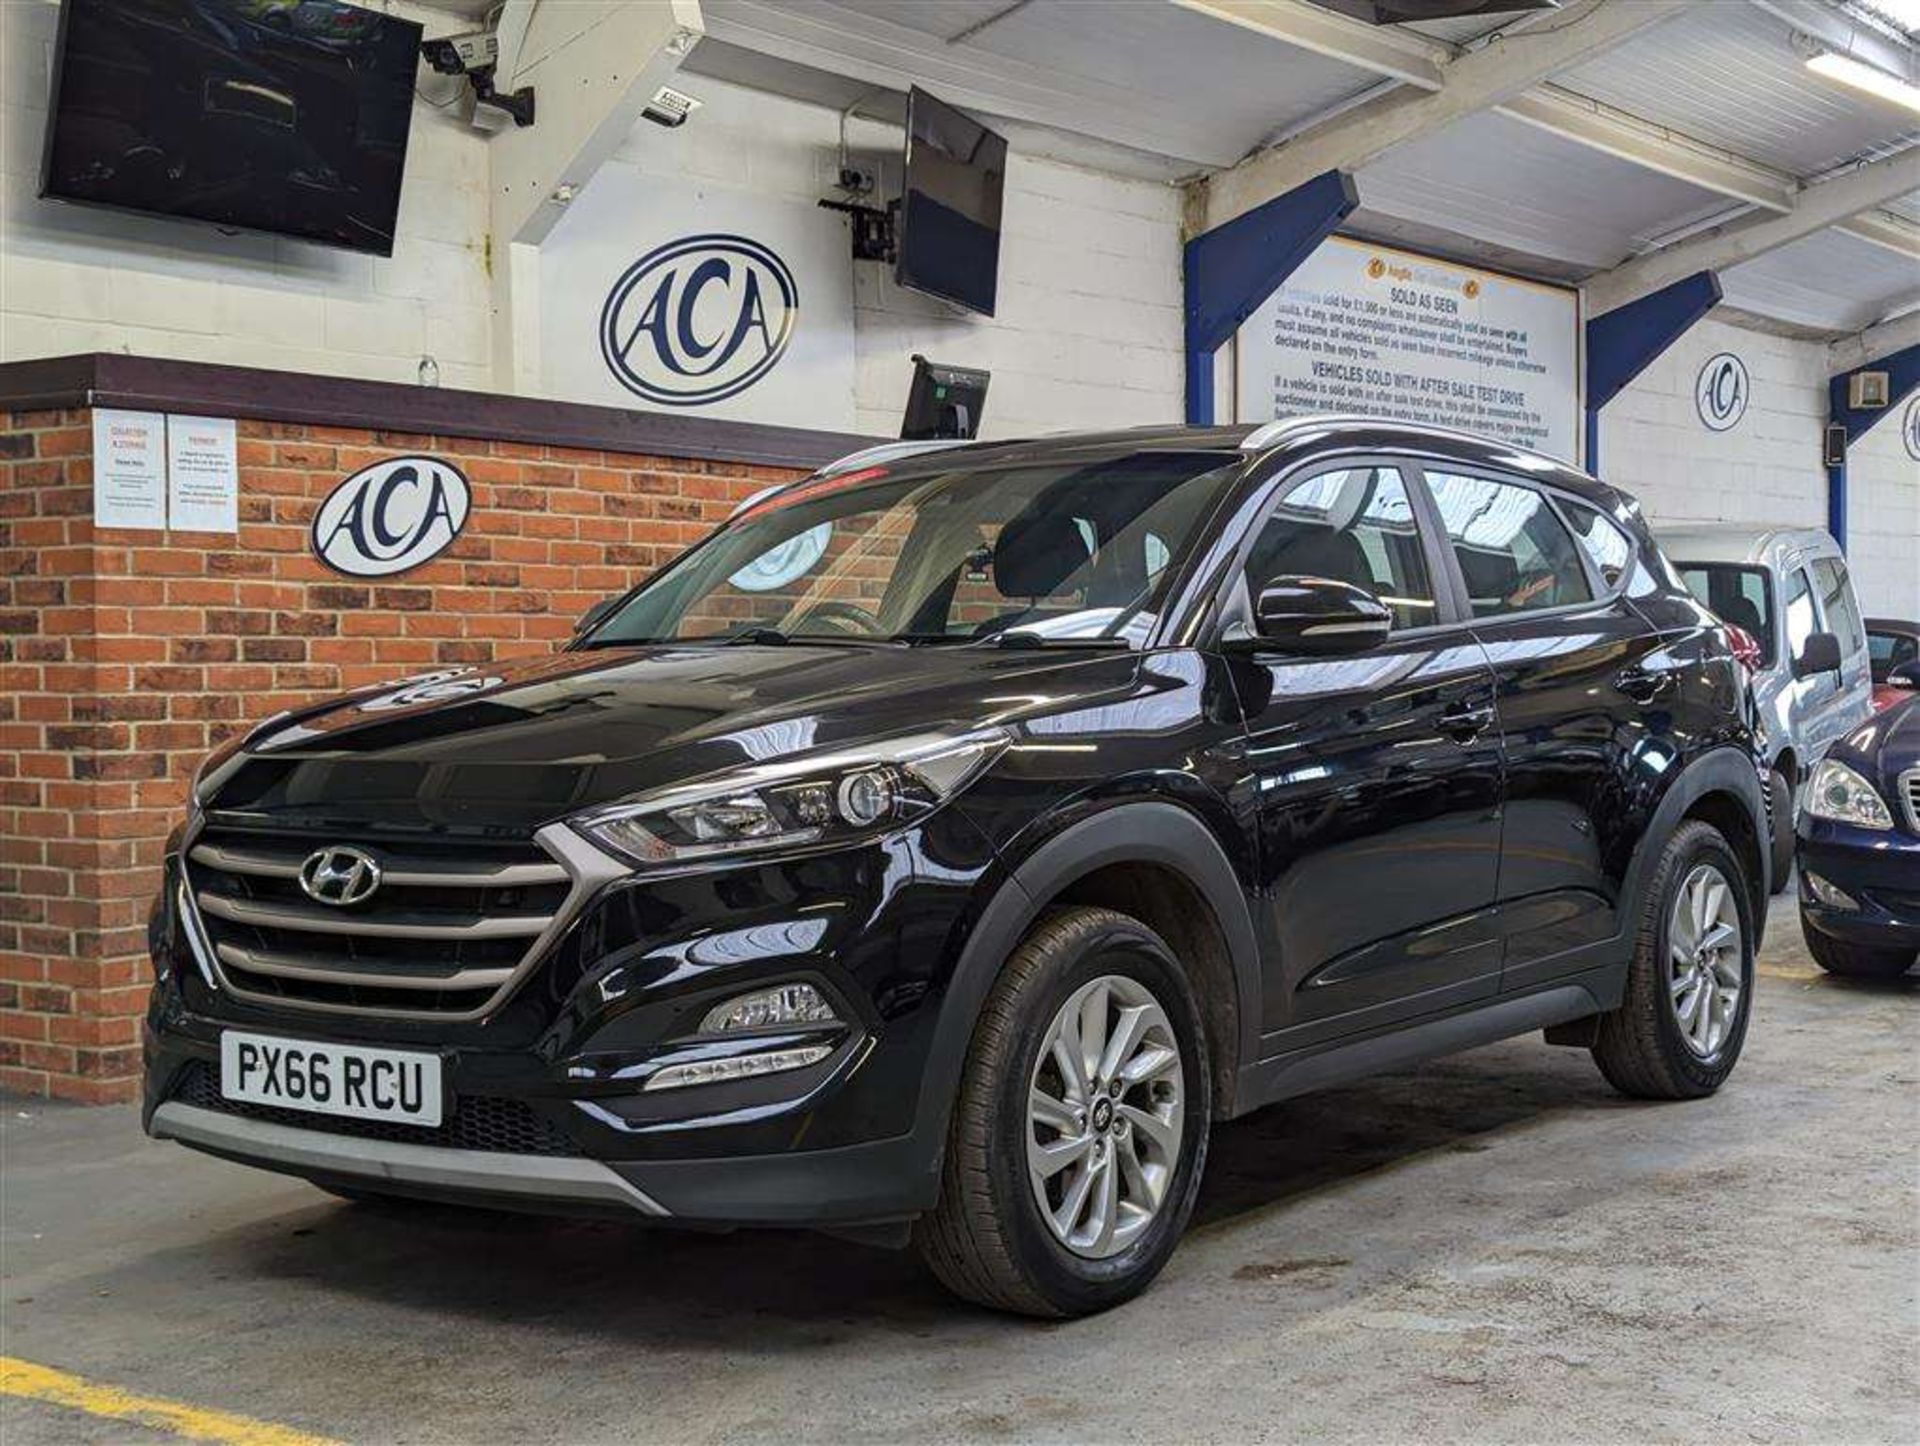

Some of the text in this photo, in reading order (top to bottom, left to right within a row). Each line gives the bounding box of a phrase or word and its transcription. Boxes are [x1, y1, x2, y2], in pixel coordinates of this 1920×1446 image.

[617, 256, 778, 379] ACA
[1390, 289, 1416, 306] SOLD
[1433, 296, 1458, 313] SEEN
[1274, 321, 1295, 331] must
[1298, 325, 1327, 336] assume
[1341, 331, 1372, 344] vehicles
[1274, 333, 1310, 349] declared
[1289, 379, 1318, 392] vehicle
[1329, 384, 1346, 396] sold
[1348, 386, 1362, 399] with
[1312, 361, 1524, 407] VEHICLES SOLD WITH AFTER SALE TEST DRIVE
[1702, 362, 1742, 420] ACA
[320, 466, 457, 562] ACA
[238, 1042, 422, 1114] PX66 RCU
